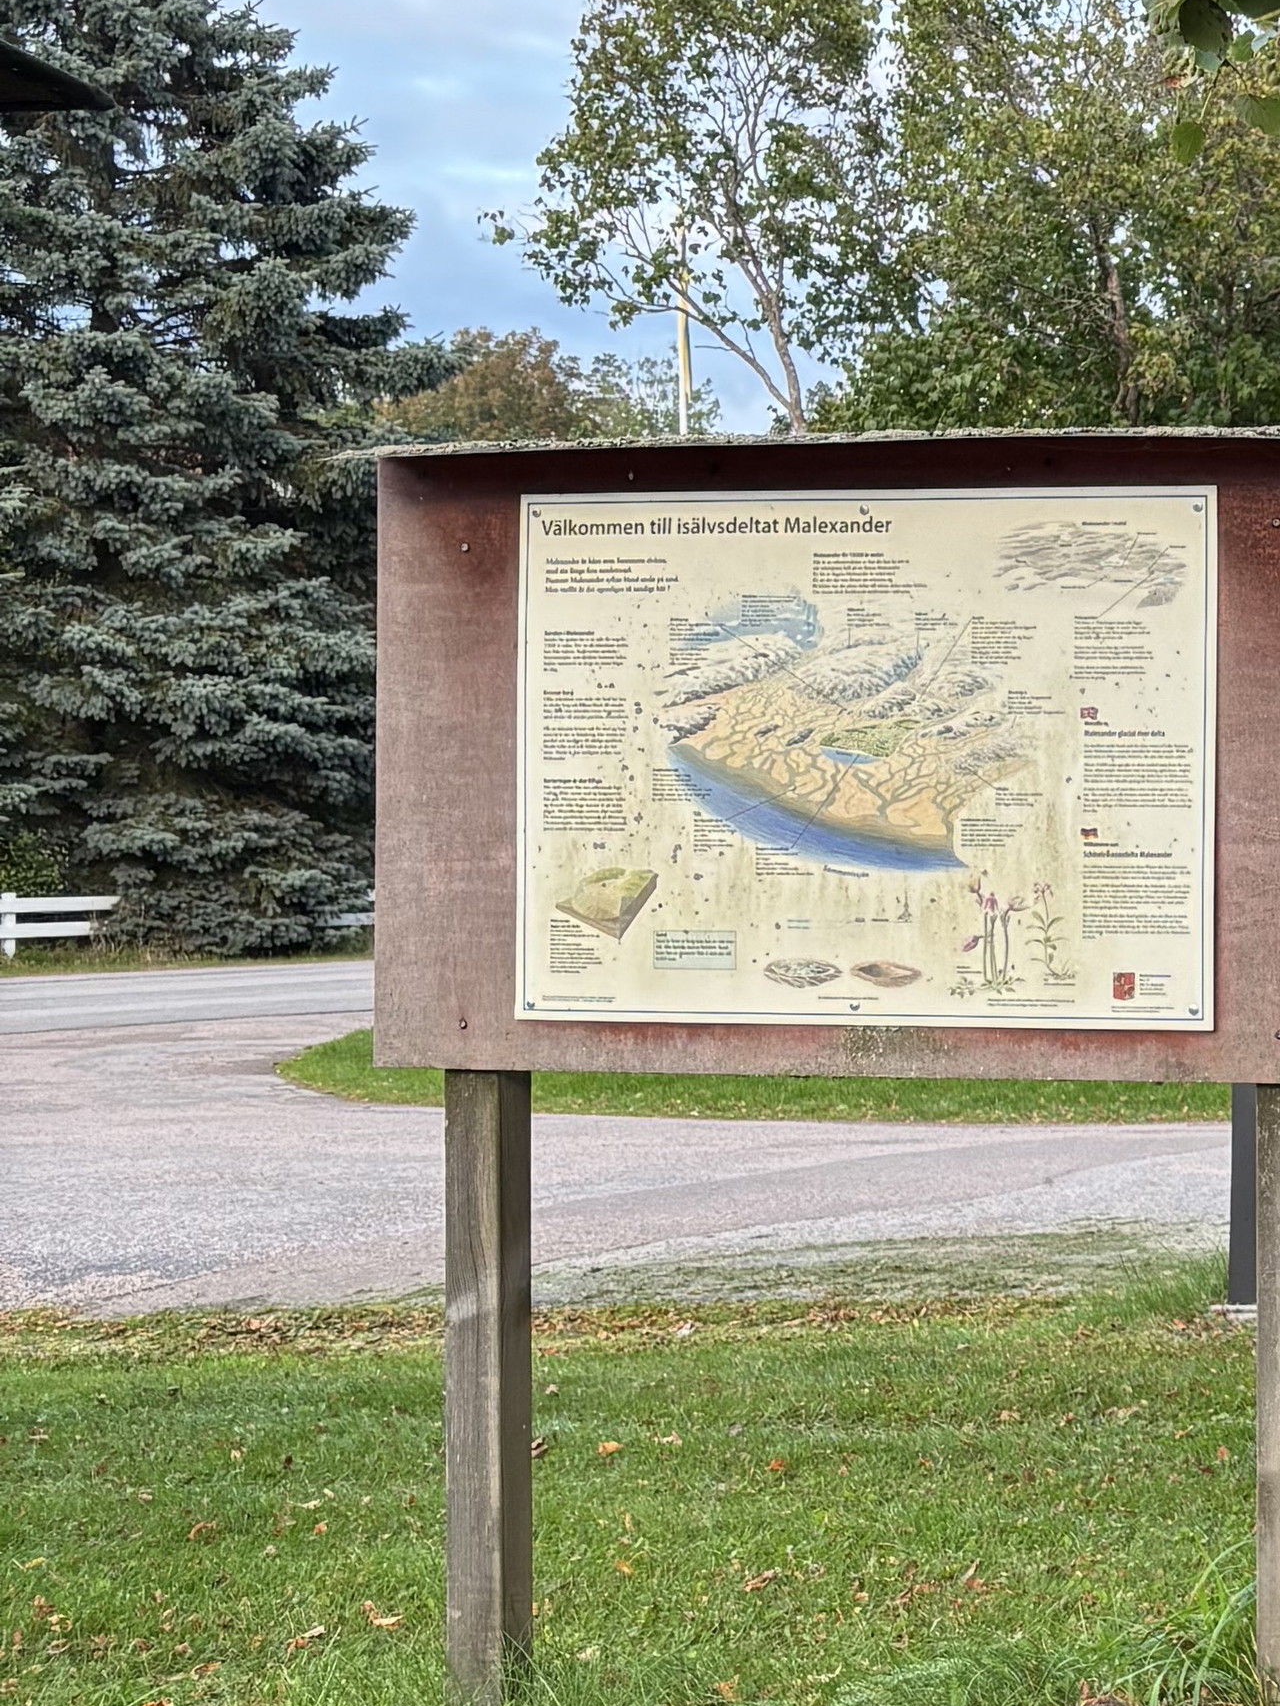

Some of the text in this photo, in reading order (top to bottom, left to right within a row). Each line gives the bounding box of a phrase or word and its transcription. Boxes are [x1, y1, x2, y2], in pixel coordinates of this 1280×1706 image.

[542, 516, 892, 535] Välkommen till isälvsdeltat Malexander
